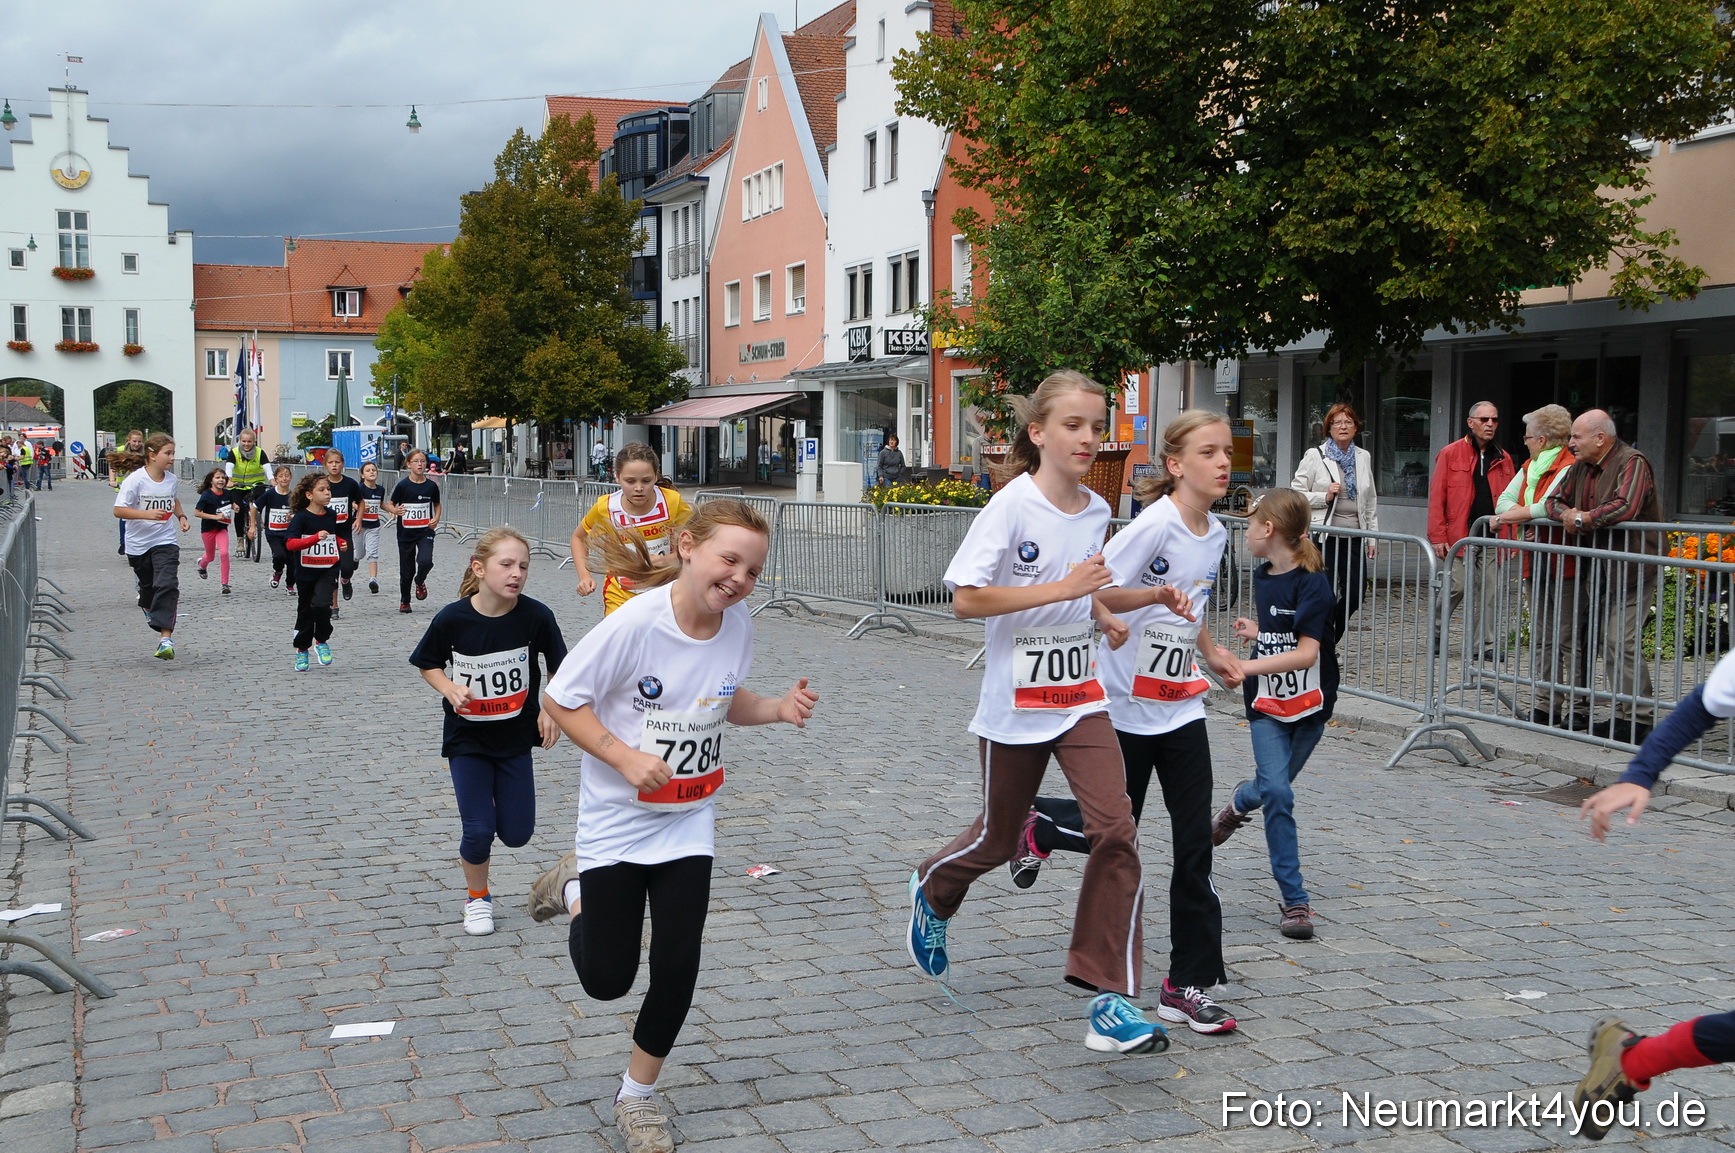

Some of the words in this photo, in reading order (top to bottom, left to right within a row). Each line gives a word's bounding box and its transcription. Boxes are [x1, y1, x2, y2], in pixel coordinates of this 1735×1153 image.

[850, 328, 867, 348] KBK
[888, 331, 928, 345] KBK
[808, 443, 814, 452] P
[145, 499, 172, 511] 7003
[272, 514, 289, 523] 733
[406, 510, 427, 519] 7301
[1013, 563, 1041, 573] PARTL
[1142, 573, 1167, 586] PARTL
[1015, 636, 1049, 646] PARTL
[1052, 632, 1087, 645] Neumarkt
[1144, 629, 1175, 643] PARTL
[478, 657, 516, 669] Neumarkt
[1026, 644, 1090, 683] 7007
[460, 668, 522, 697] 7198
[633, 697, 663, 711] PARTL
[1042, 690, 1086, 705] Louisa
[480, 702, 509, 713] Alina
[646, 719, 685, 733] PARTL
[655, 733, 722, 775] 7284
[677, 783, 706, 799] Lucy
